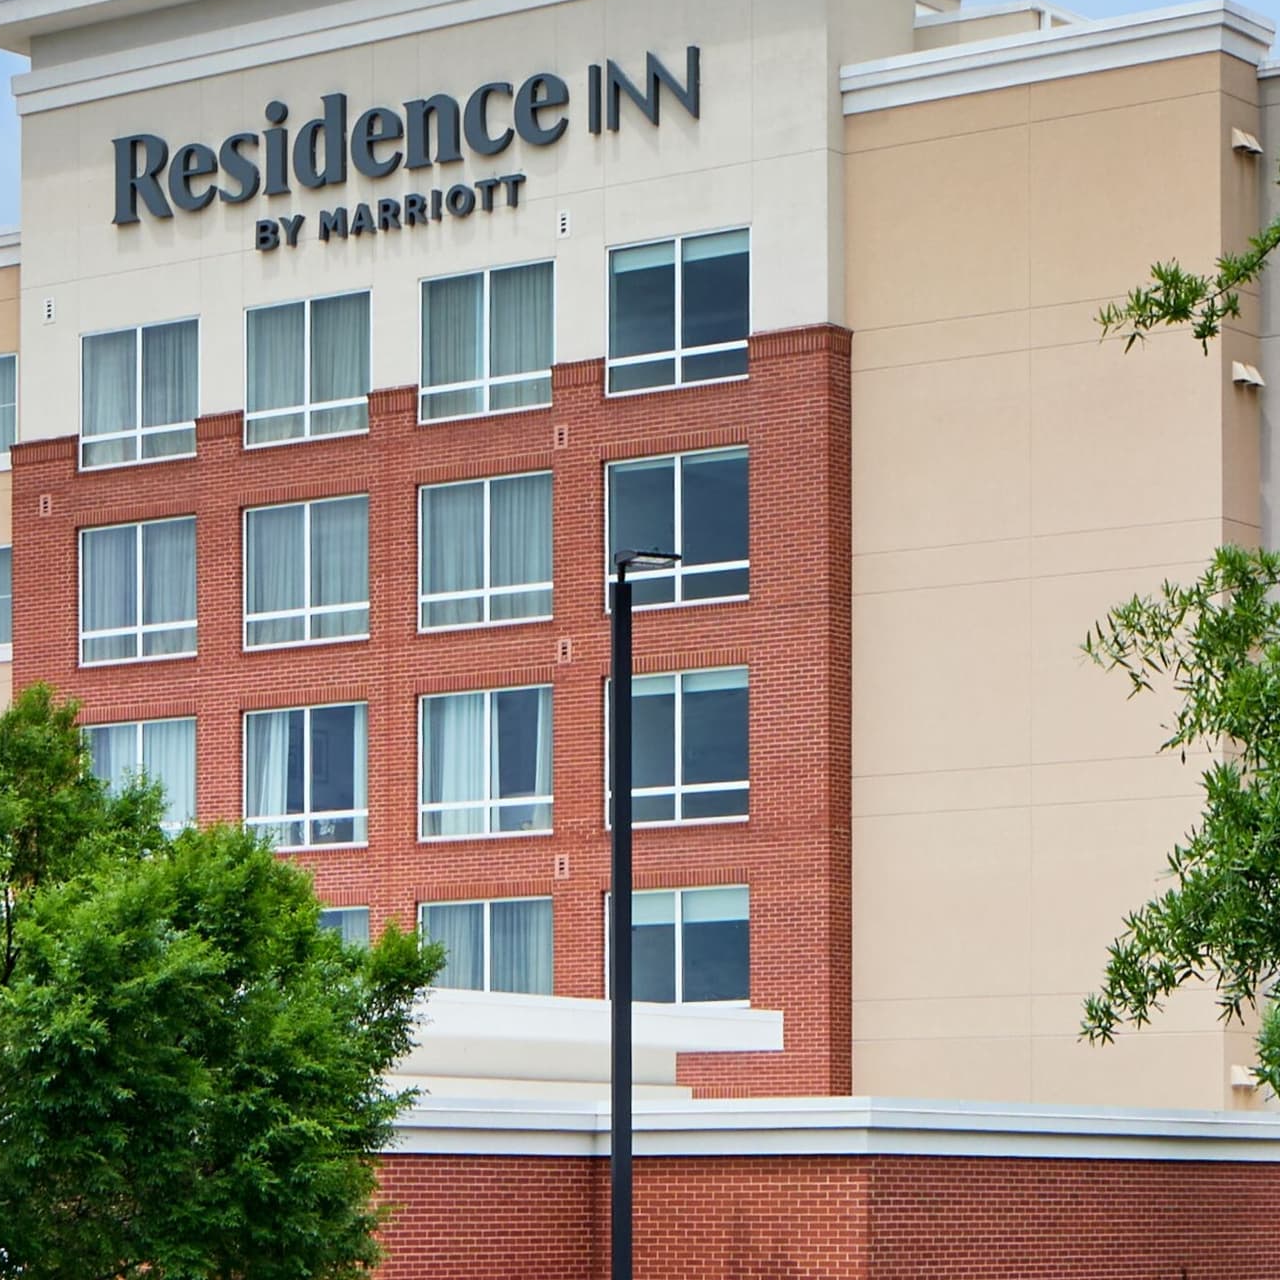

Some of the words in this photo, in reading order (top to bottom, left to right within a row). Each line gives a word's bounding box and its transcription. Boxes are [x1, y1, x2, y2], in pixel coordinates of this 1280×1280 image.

[111, 72, 570, 226] Residence
[588, 45, 701, 135] INN
[255, 214, 306, 252] BY
[318, 173, 526, 242] MARRIOTT
